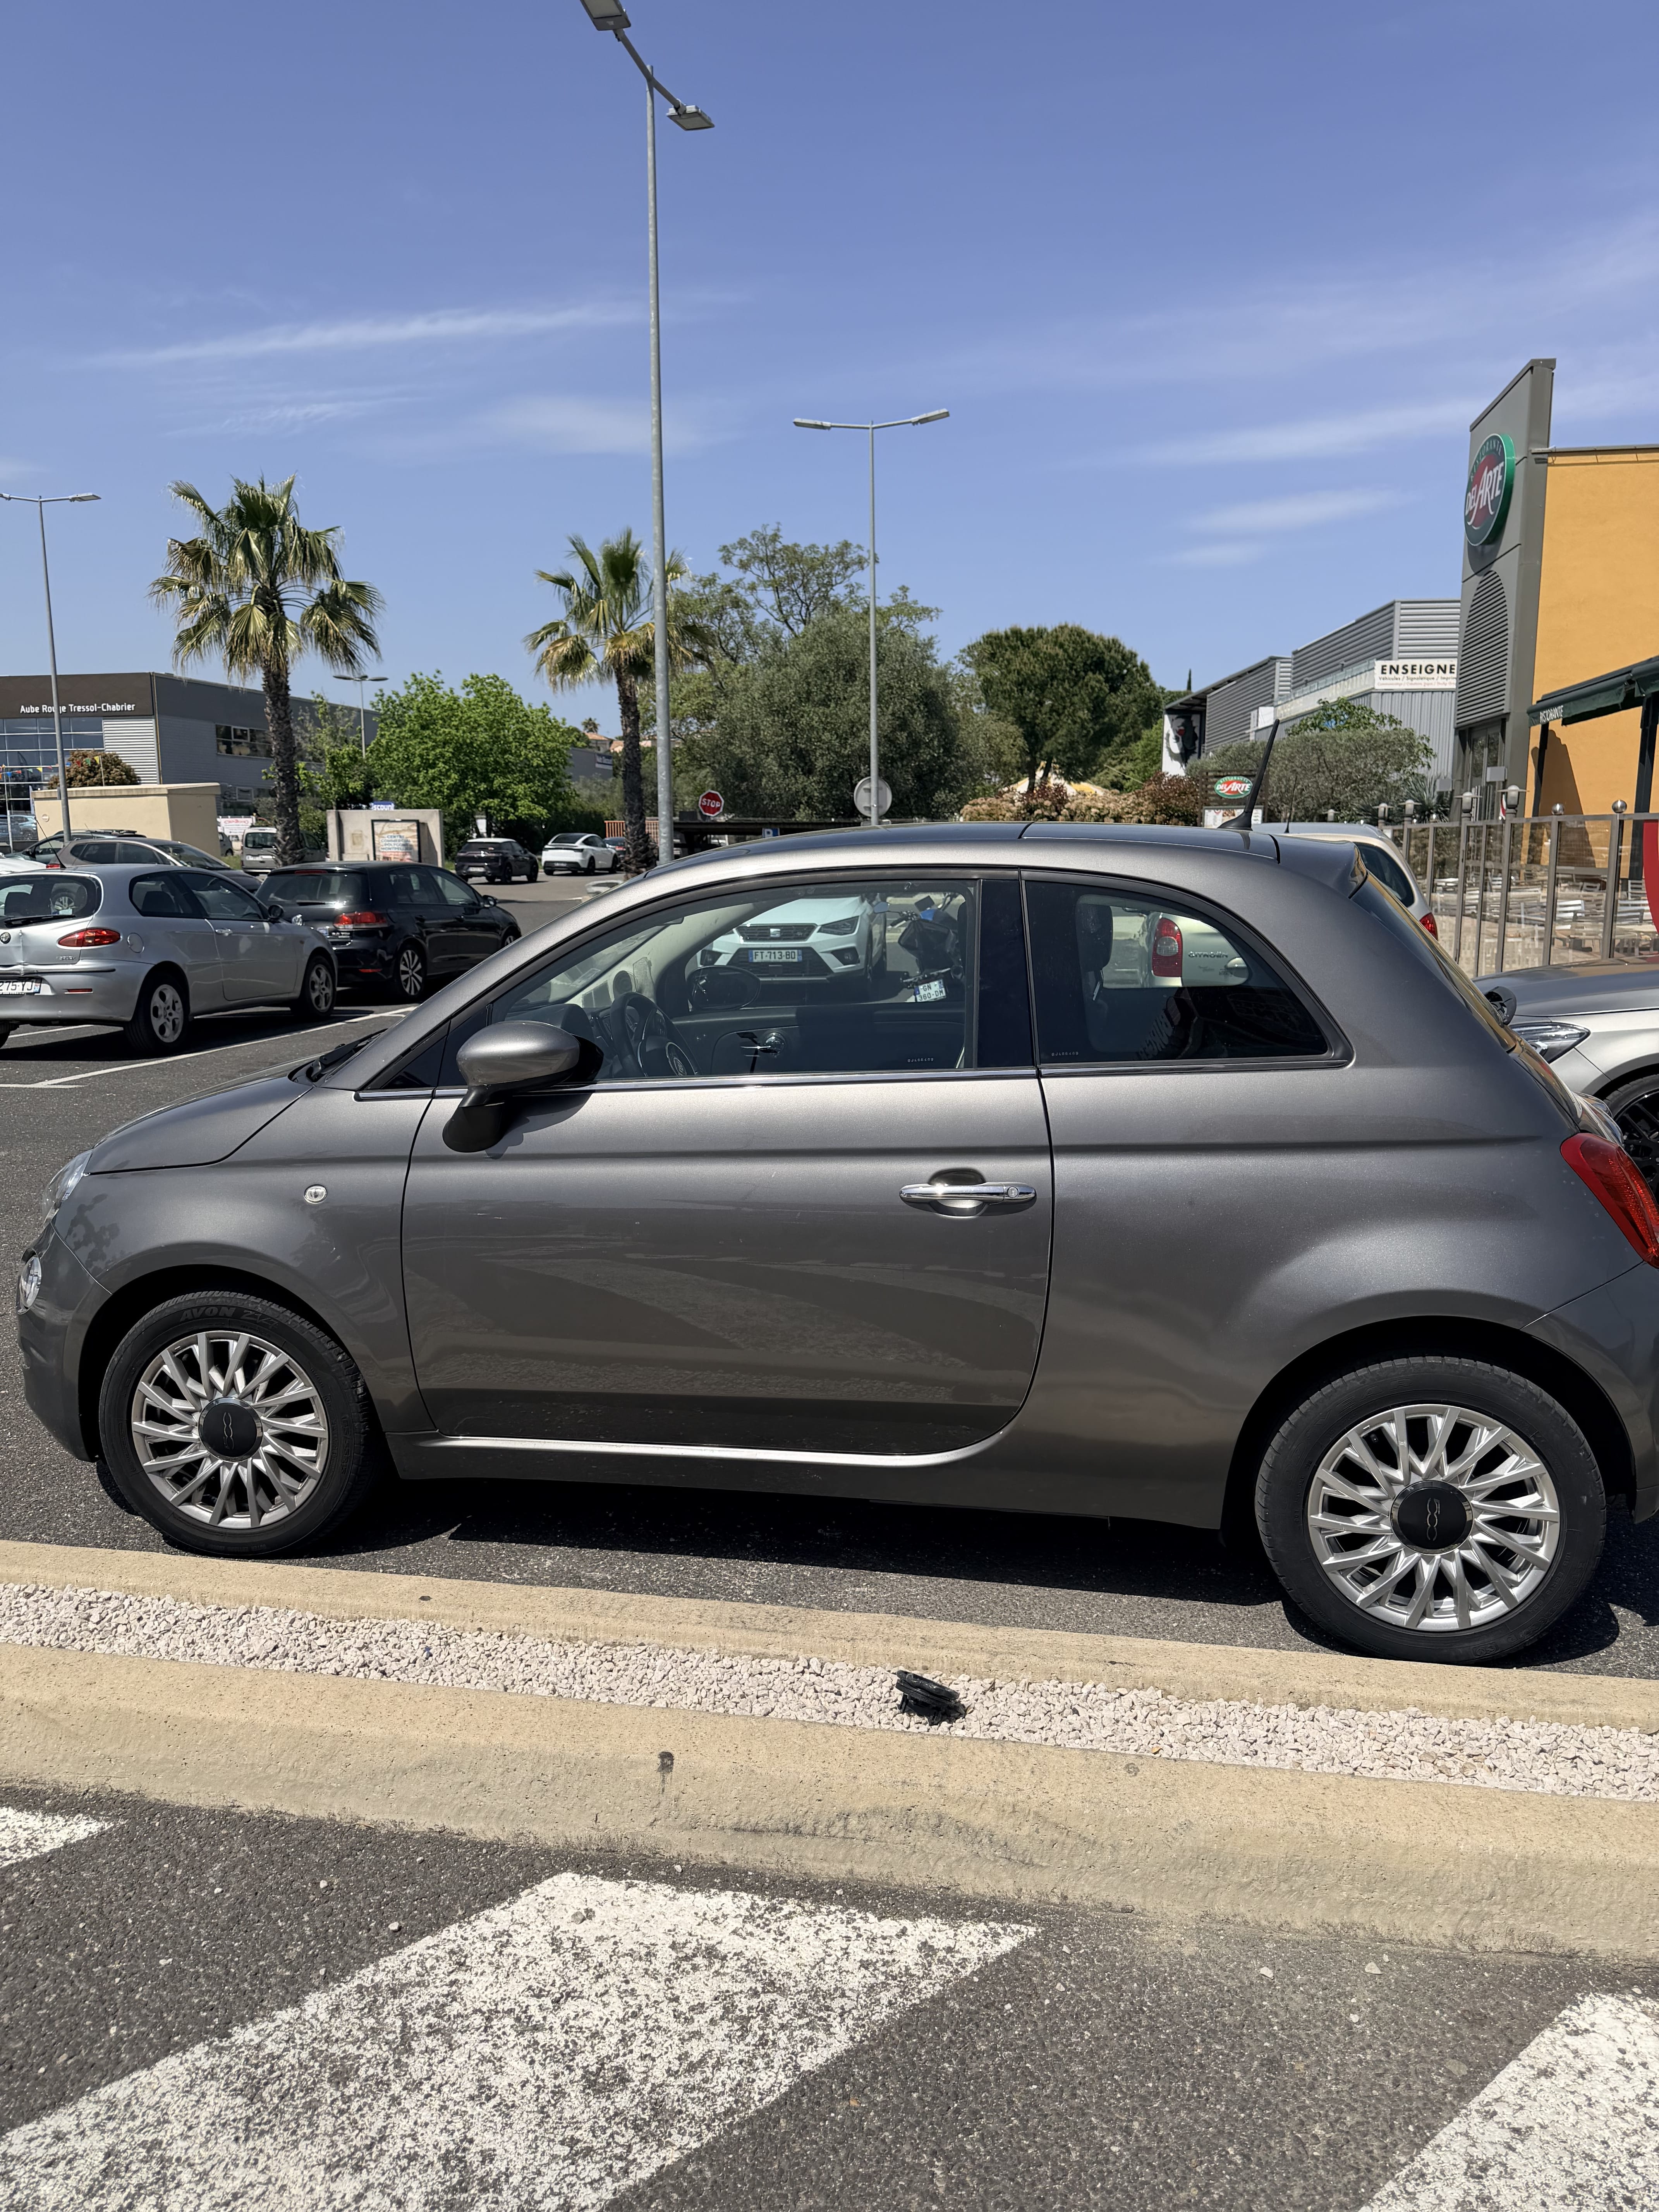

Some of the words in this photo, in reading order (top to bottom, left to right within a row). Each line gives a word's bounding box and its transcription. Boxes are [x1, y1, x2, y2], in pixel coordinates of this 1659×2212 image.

[1381, 664, 1455, 675] ENSEIGNE
[20, 705, 39, 713] Aube
[69, 702, 135, 713] Tressol-Chabrier
[701, 798, 721, 807] STOP
[918, 989, 944, 1001] 360-DM
[179, 1306, 236, 1322] AVON
